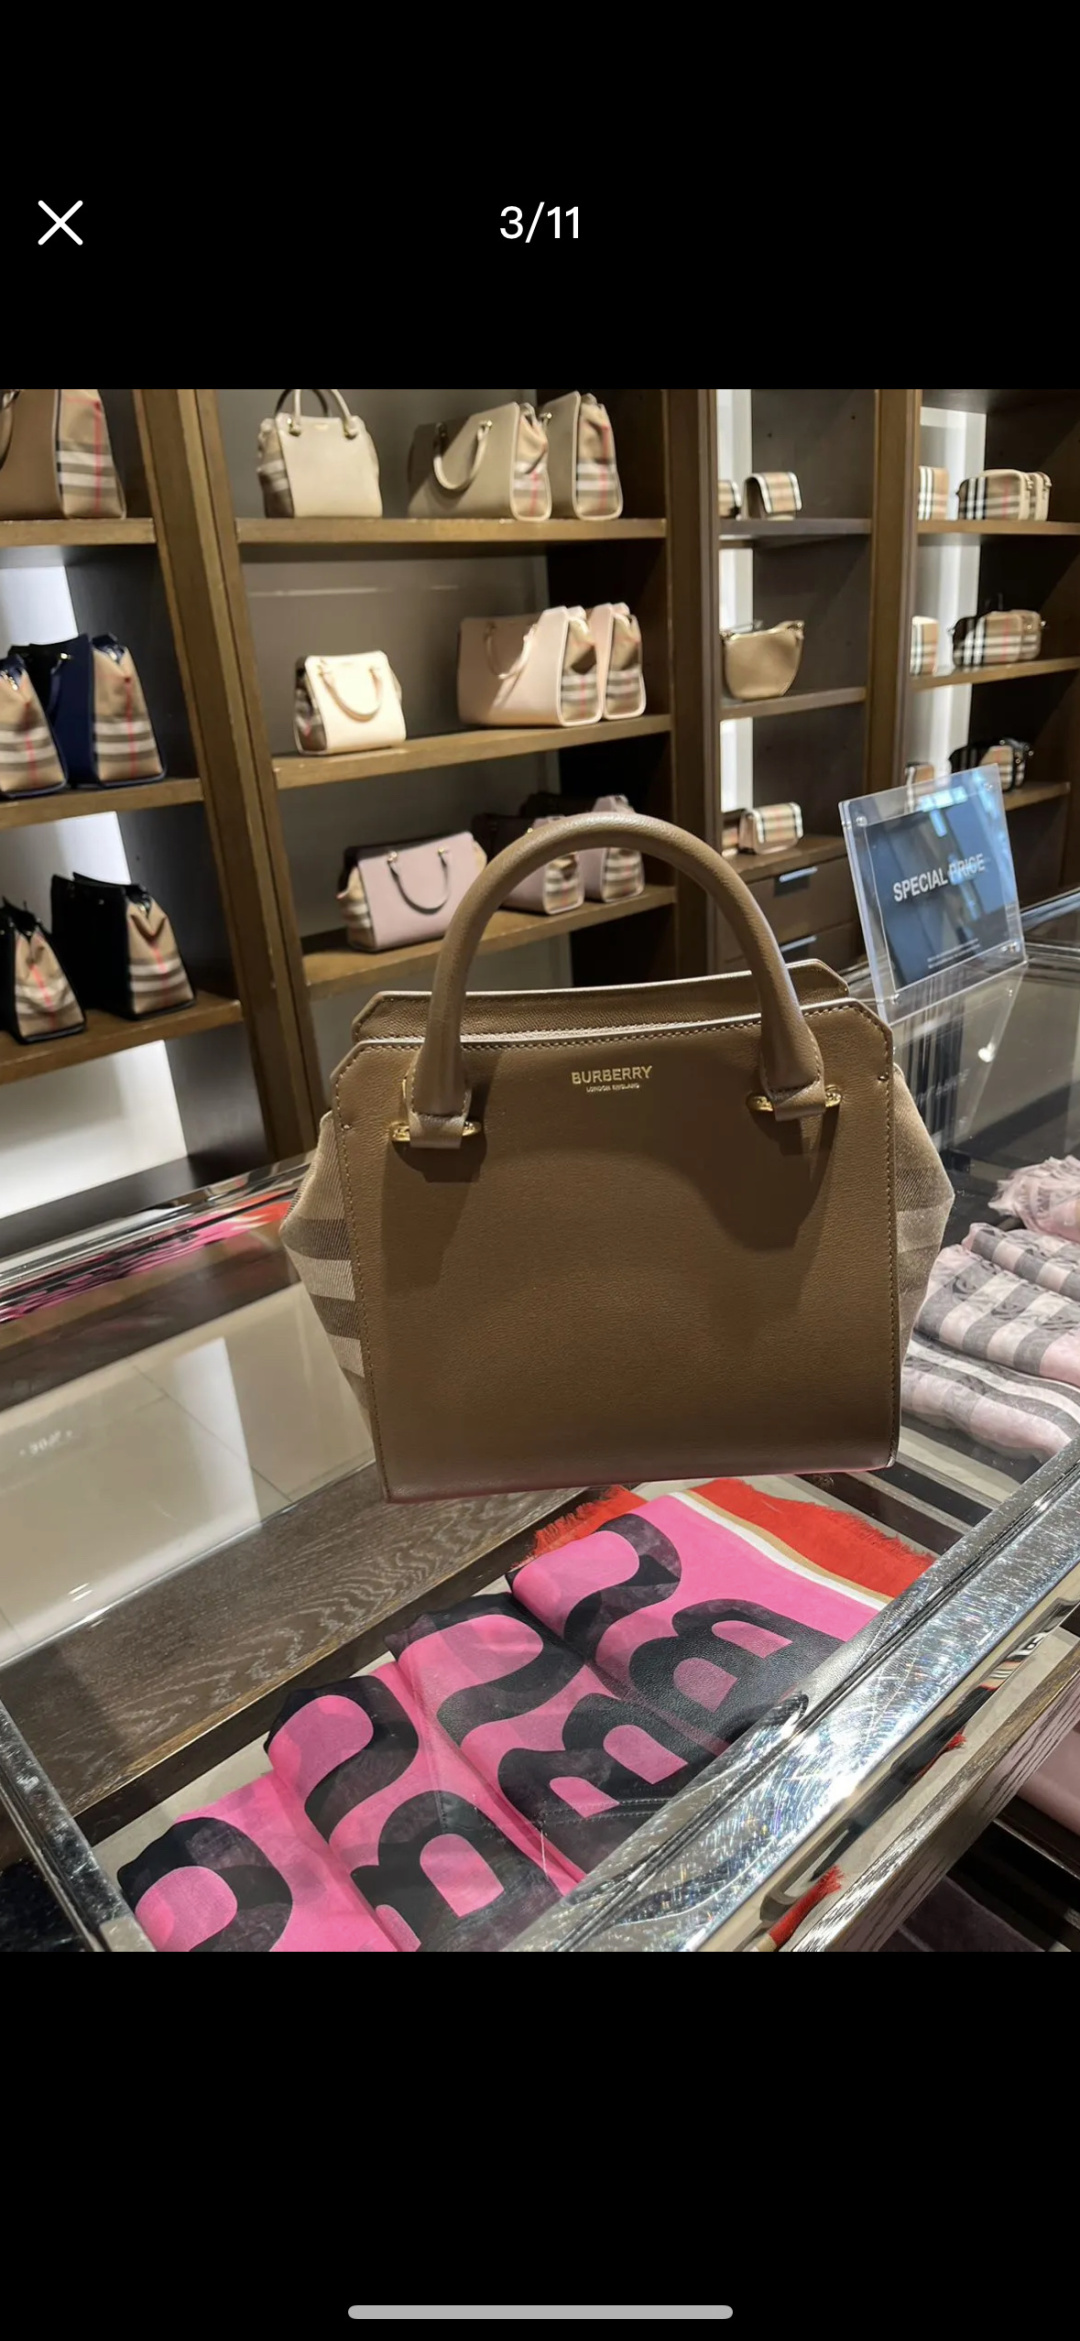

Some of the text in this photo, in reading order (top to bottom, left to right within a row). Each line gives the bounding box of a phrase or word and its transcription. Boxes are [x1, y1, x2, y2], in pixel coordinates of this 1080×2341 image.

[893, 853, 985, 902] SPECIAL PRICE
[571, 1065, 652, 1085] BURBERRY
